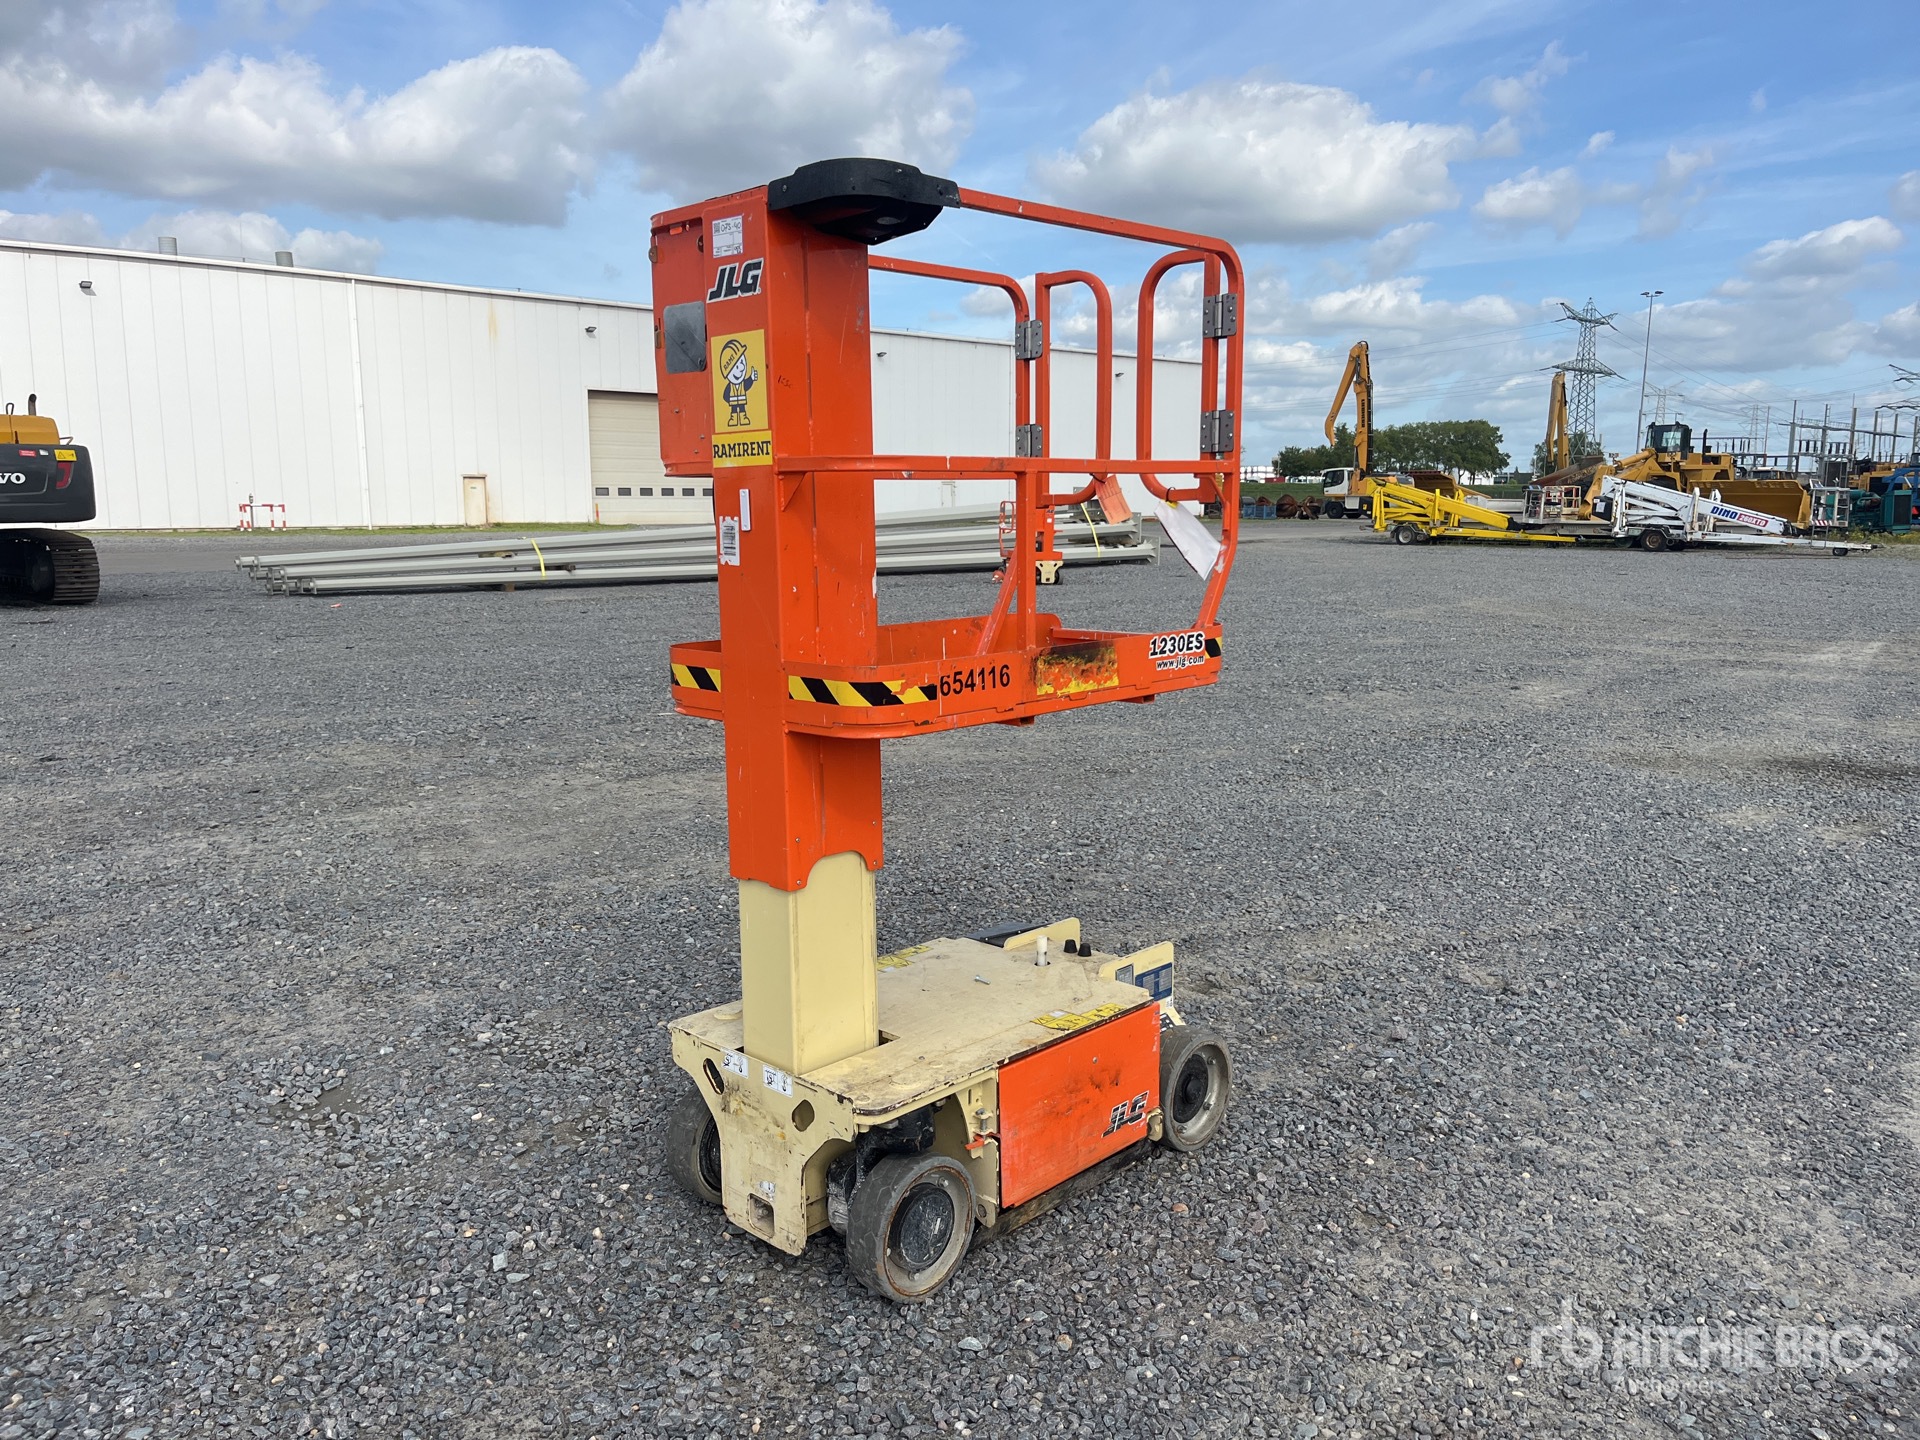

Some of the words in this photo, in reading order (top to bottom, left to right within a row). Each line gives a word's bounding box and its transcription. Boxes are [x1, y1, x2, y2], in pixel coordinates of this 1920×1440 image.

[707, 258, 763, 302] JLG
[723, 353, 736, 371] RAMI
[713, 440, 771, 459] RAMIRENT
[1710, 505, 1738, 520] DINO
[1150, 632, 1204, 657] 1230ES
[1156, 655, 1205, 670] www.jlg.com
[940, 664, 1010, 697] 654116
